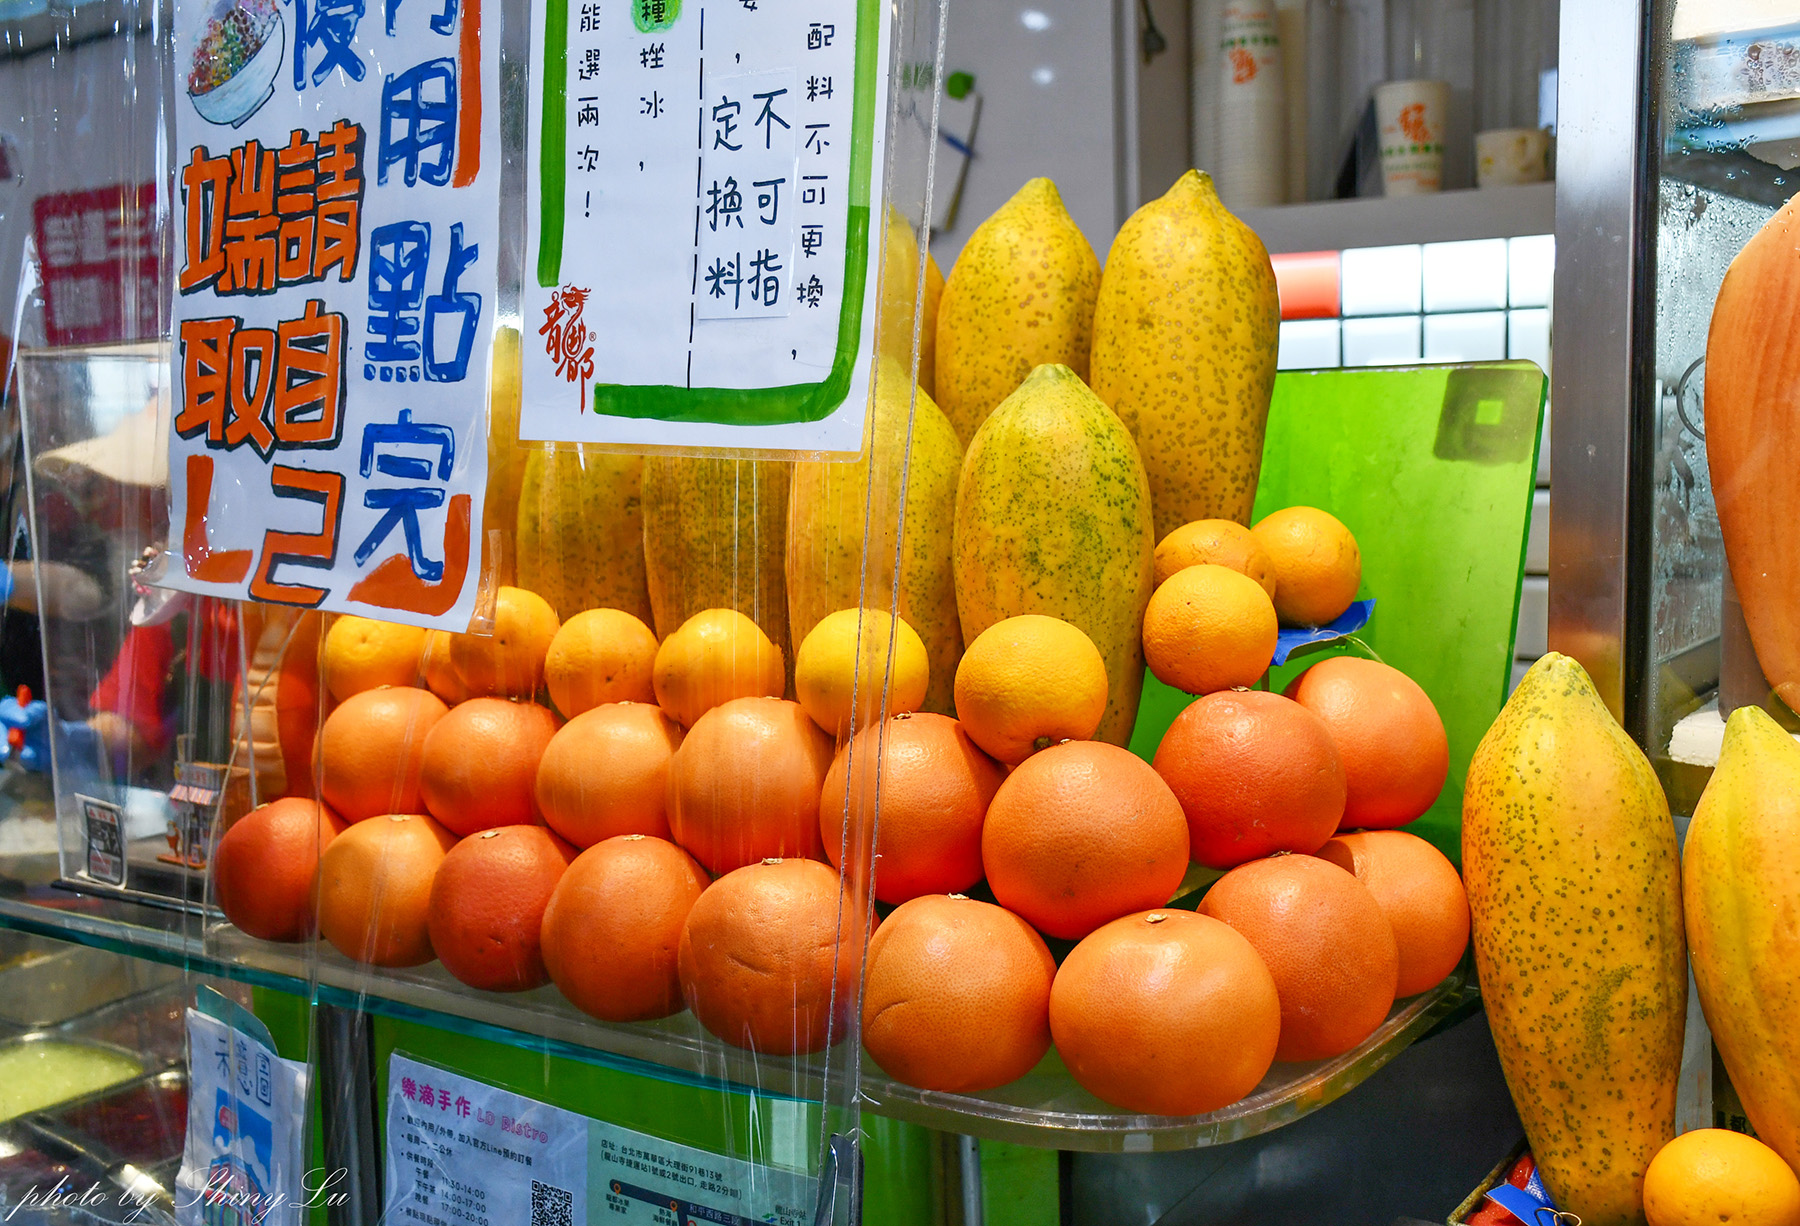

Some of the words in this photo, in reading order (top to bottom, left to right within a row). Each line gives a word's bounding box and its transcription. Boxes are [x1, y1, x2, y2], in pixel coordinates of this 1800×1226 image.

[401, 1076, 471, 1118] 樂滴手作
[501, 1115, 549, 1144] Bistro
